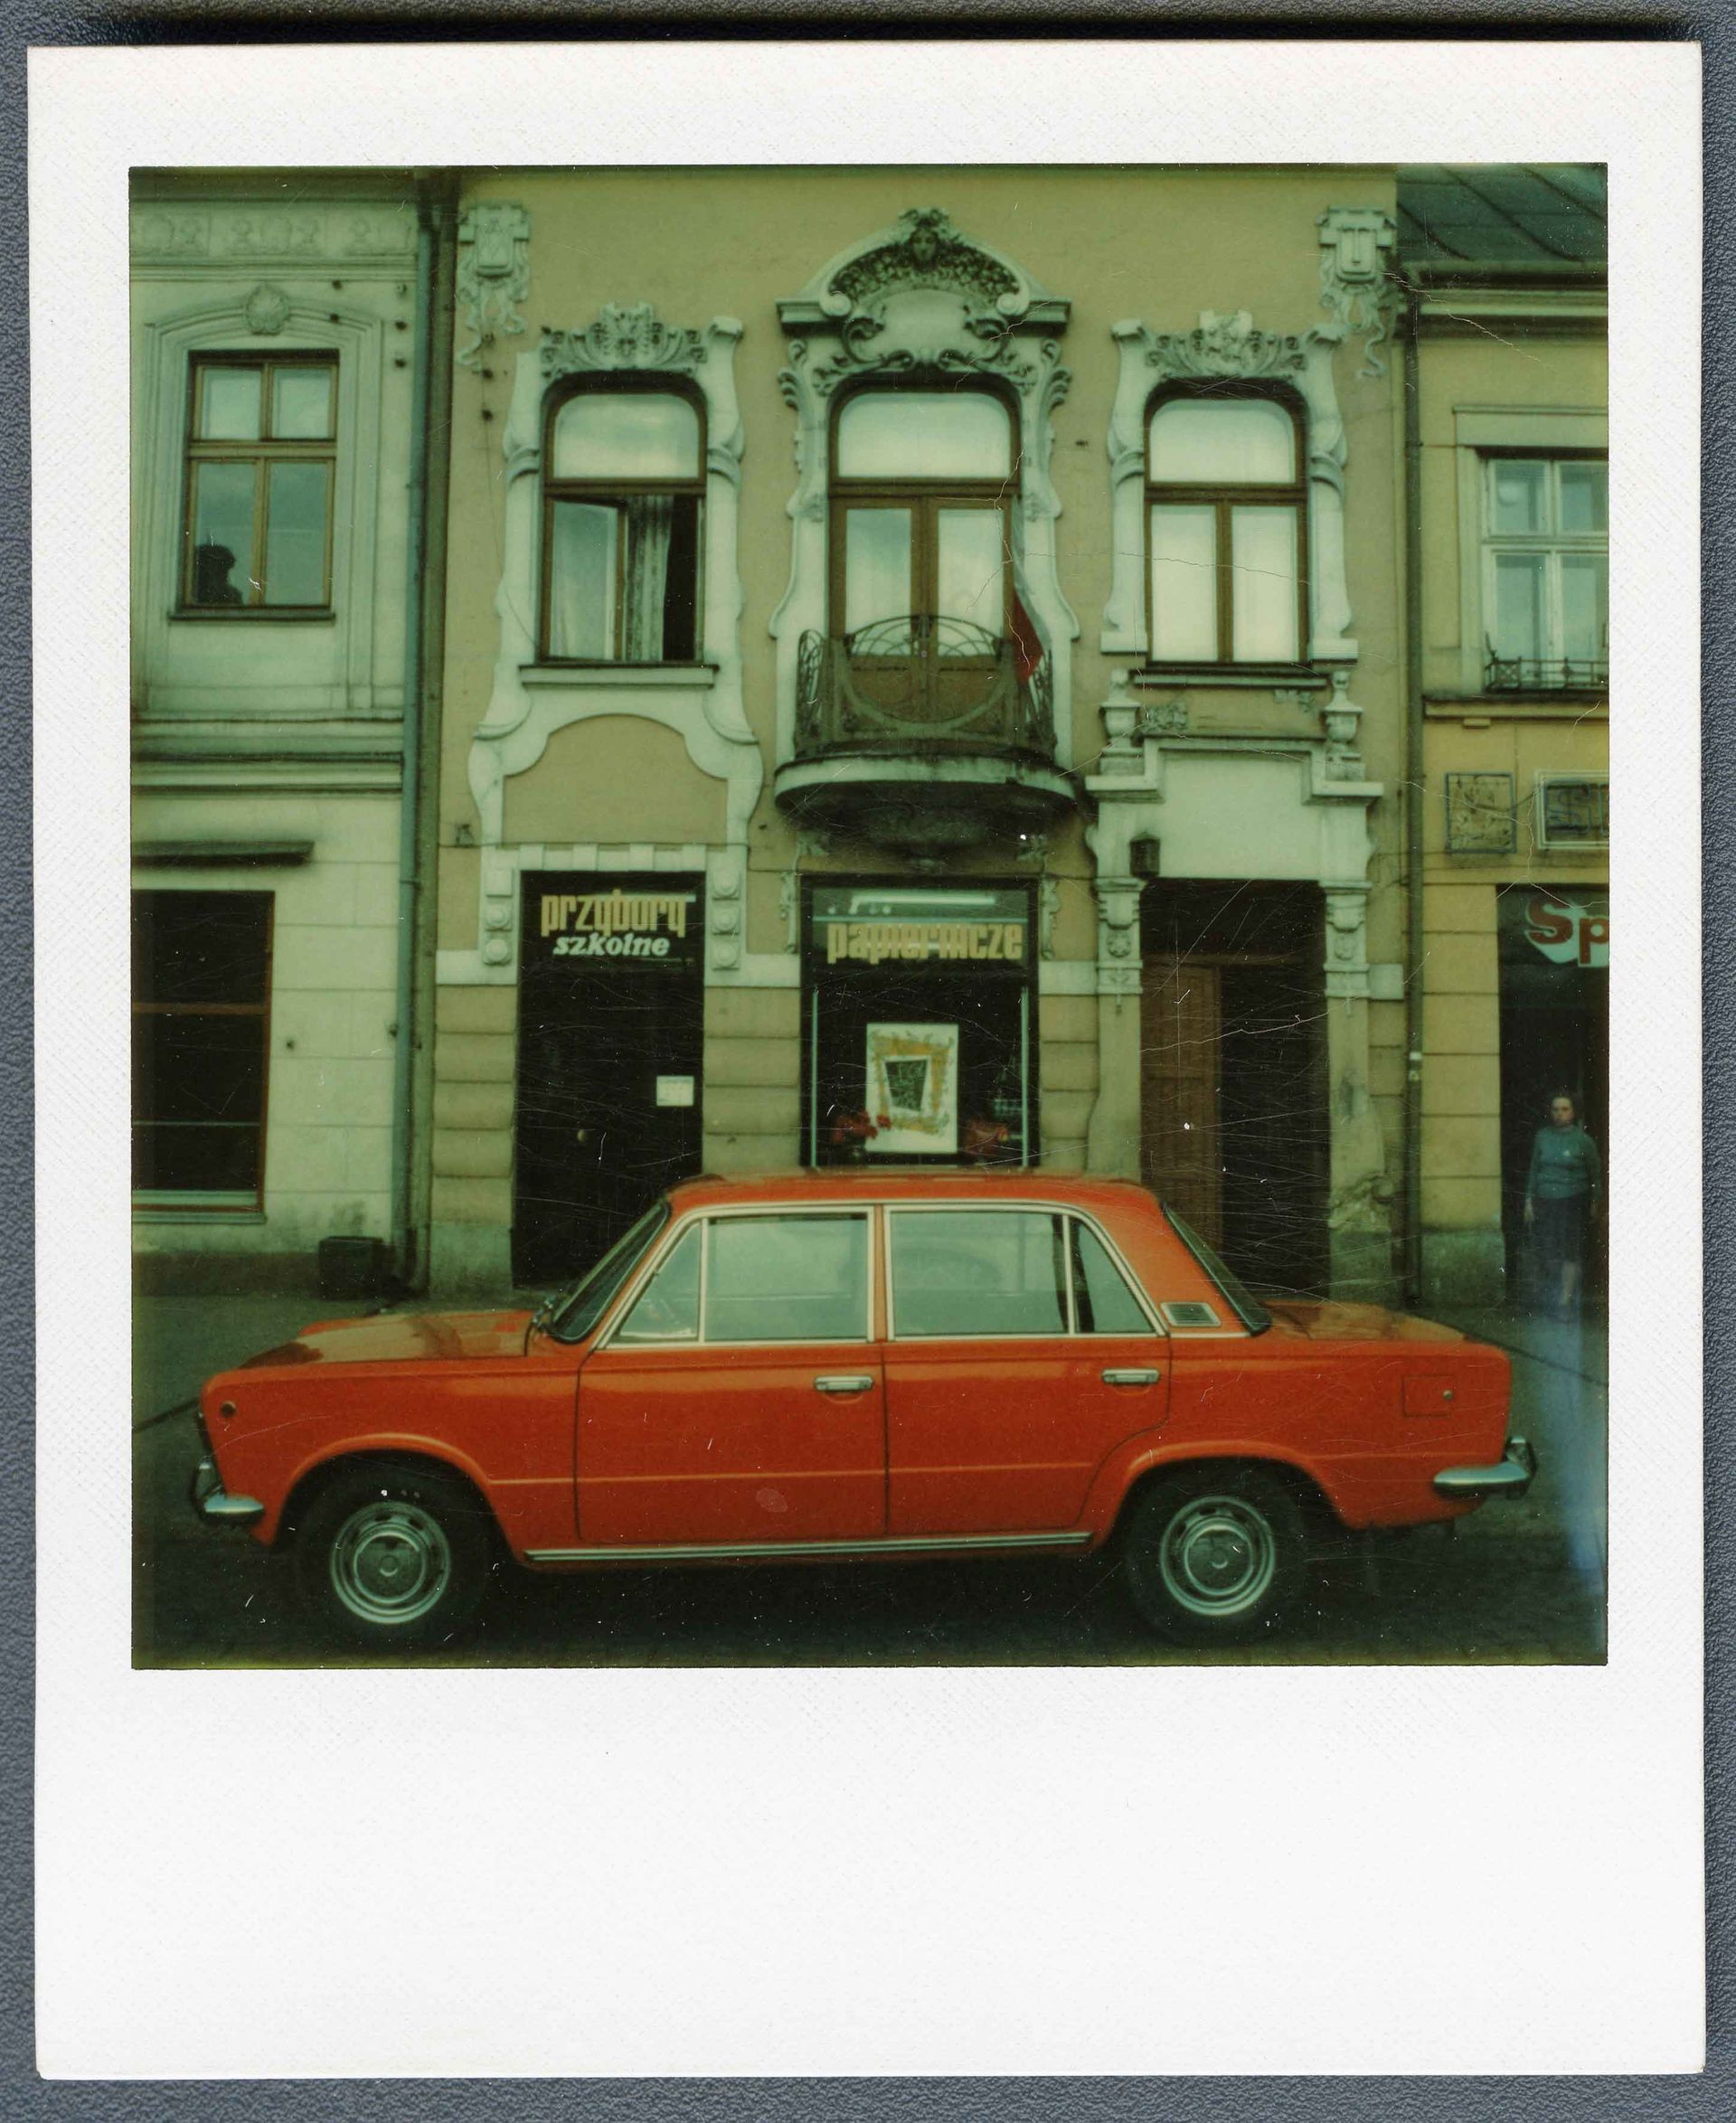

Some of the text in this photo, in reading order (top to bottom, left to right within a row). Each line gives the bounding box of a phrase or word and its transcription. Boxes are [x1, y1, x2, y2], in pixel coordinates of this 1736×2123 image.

[541, 888, 686, 938] przybory
[552, 932, 671, 957] szkolne
[827, 923, 1023, 965] papiernicze
